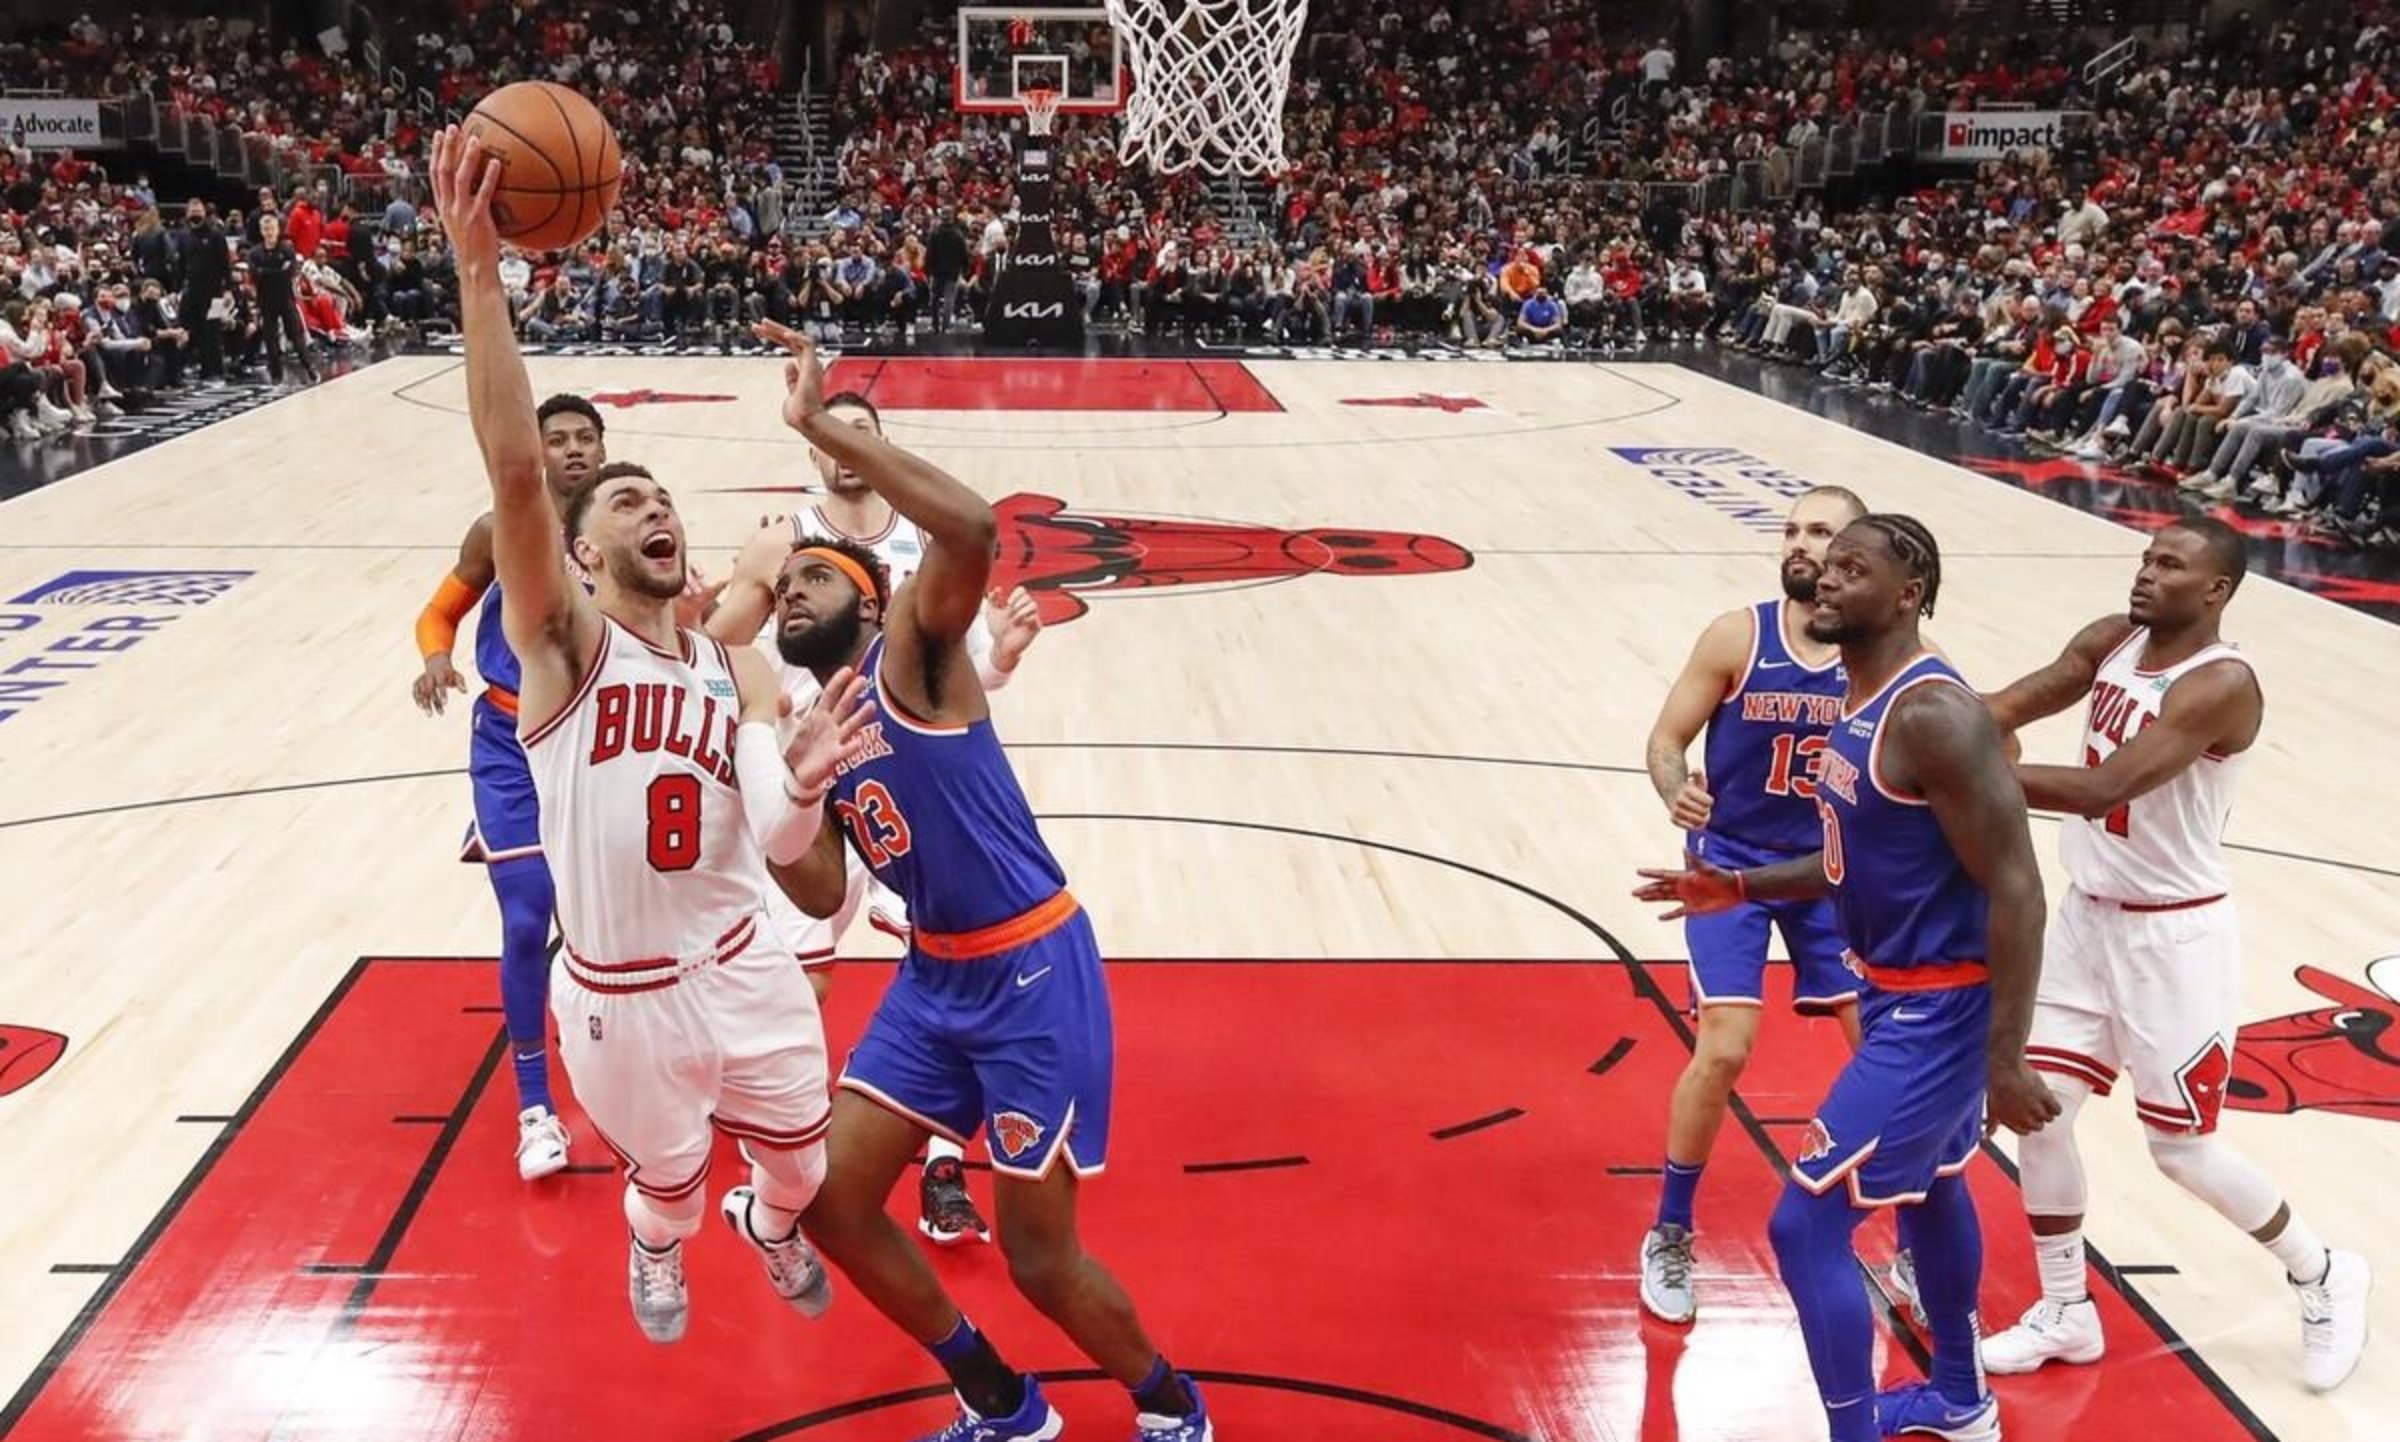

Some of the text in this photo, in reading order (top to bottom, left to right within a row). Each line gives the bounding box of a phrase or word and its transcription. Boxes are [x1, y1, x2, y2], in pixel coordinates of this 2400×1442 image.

[12, 112, 94, 133] Advocate
[1967, 118, 2055, 151] impact
[1741, 691, 1842, 726] NEW YO
[1764, 733, 1831, 799] 13
[646, 773, 702, 873] 8
[834, 778, 912, 869] 23
[1817, 797, 1845, 887] 0
